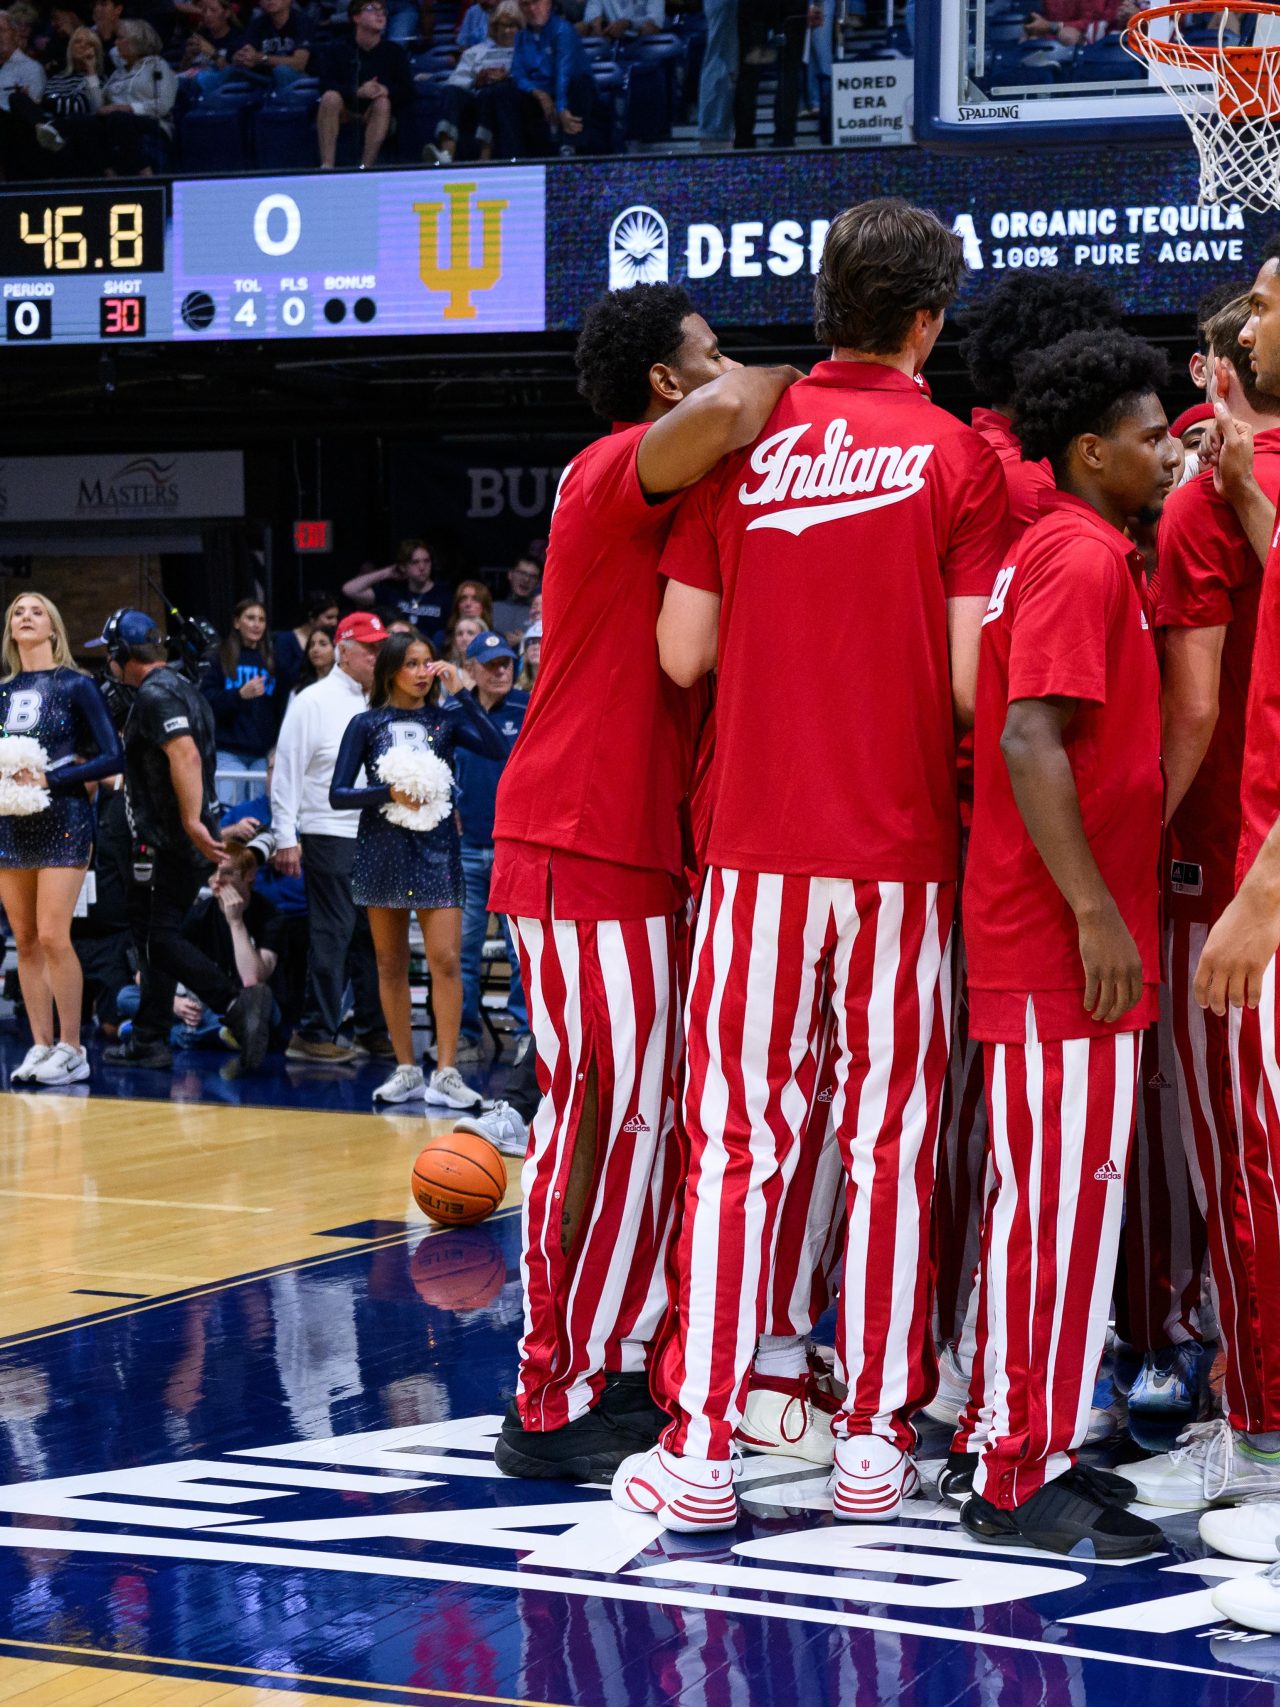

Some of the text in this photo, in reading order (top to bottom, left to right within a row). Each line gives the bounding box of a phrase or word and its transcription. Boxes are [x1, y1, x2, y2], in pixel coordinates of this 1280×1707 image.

[838, 75, 896, 91] NORED
[853, 96, 886, 110] ERA
[958, 105, 1019, 121] SPALDING
[838, 115, 903, 130] Loading
[253, 194, 301, 256] 0
[990, 207, 1117, 239] ORGANIC
[1125, 204, 1245, 237] TEQUILA
[20, 203, 143, 269] 46.8
[991, 239, 1244, 270] 100% PURE AGAVE
[3, 279, 143, 297] PERIOD SHOT
[233, 275, 376, 293] TOL FLS BONUS
[14, 298, 141, 335] 0 30
[234, 296, 306, 327] 4 0
[739, 418, 935, 535] Indiana
[5, 690, 43, 733] B
[623, 1124, 651, 1133] adidas
[1094, 1171, 1122, 1181] adidas
[1195, 1628, 1272, 1643] TM
